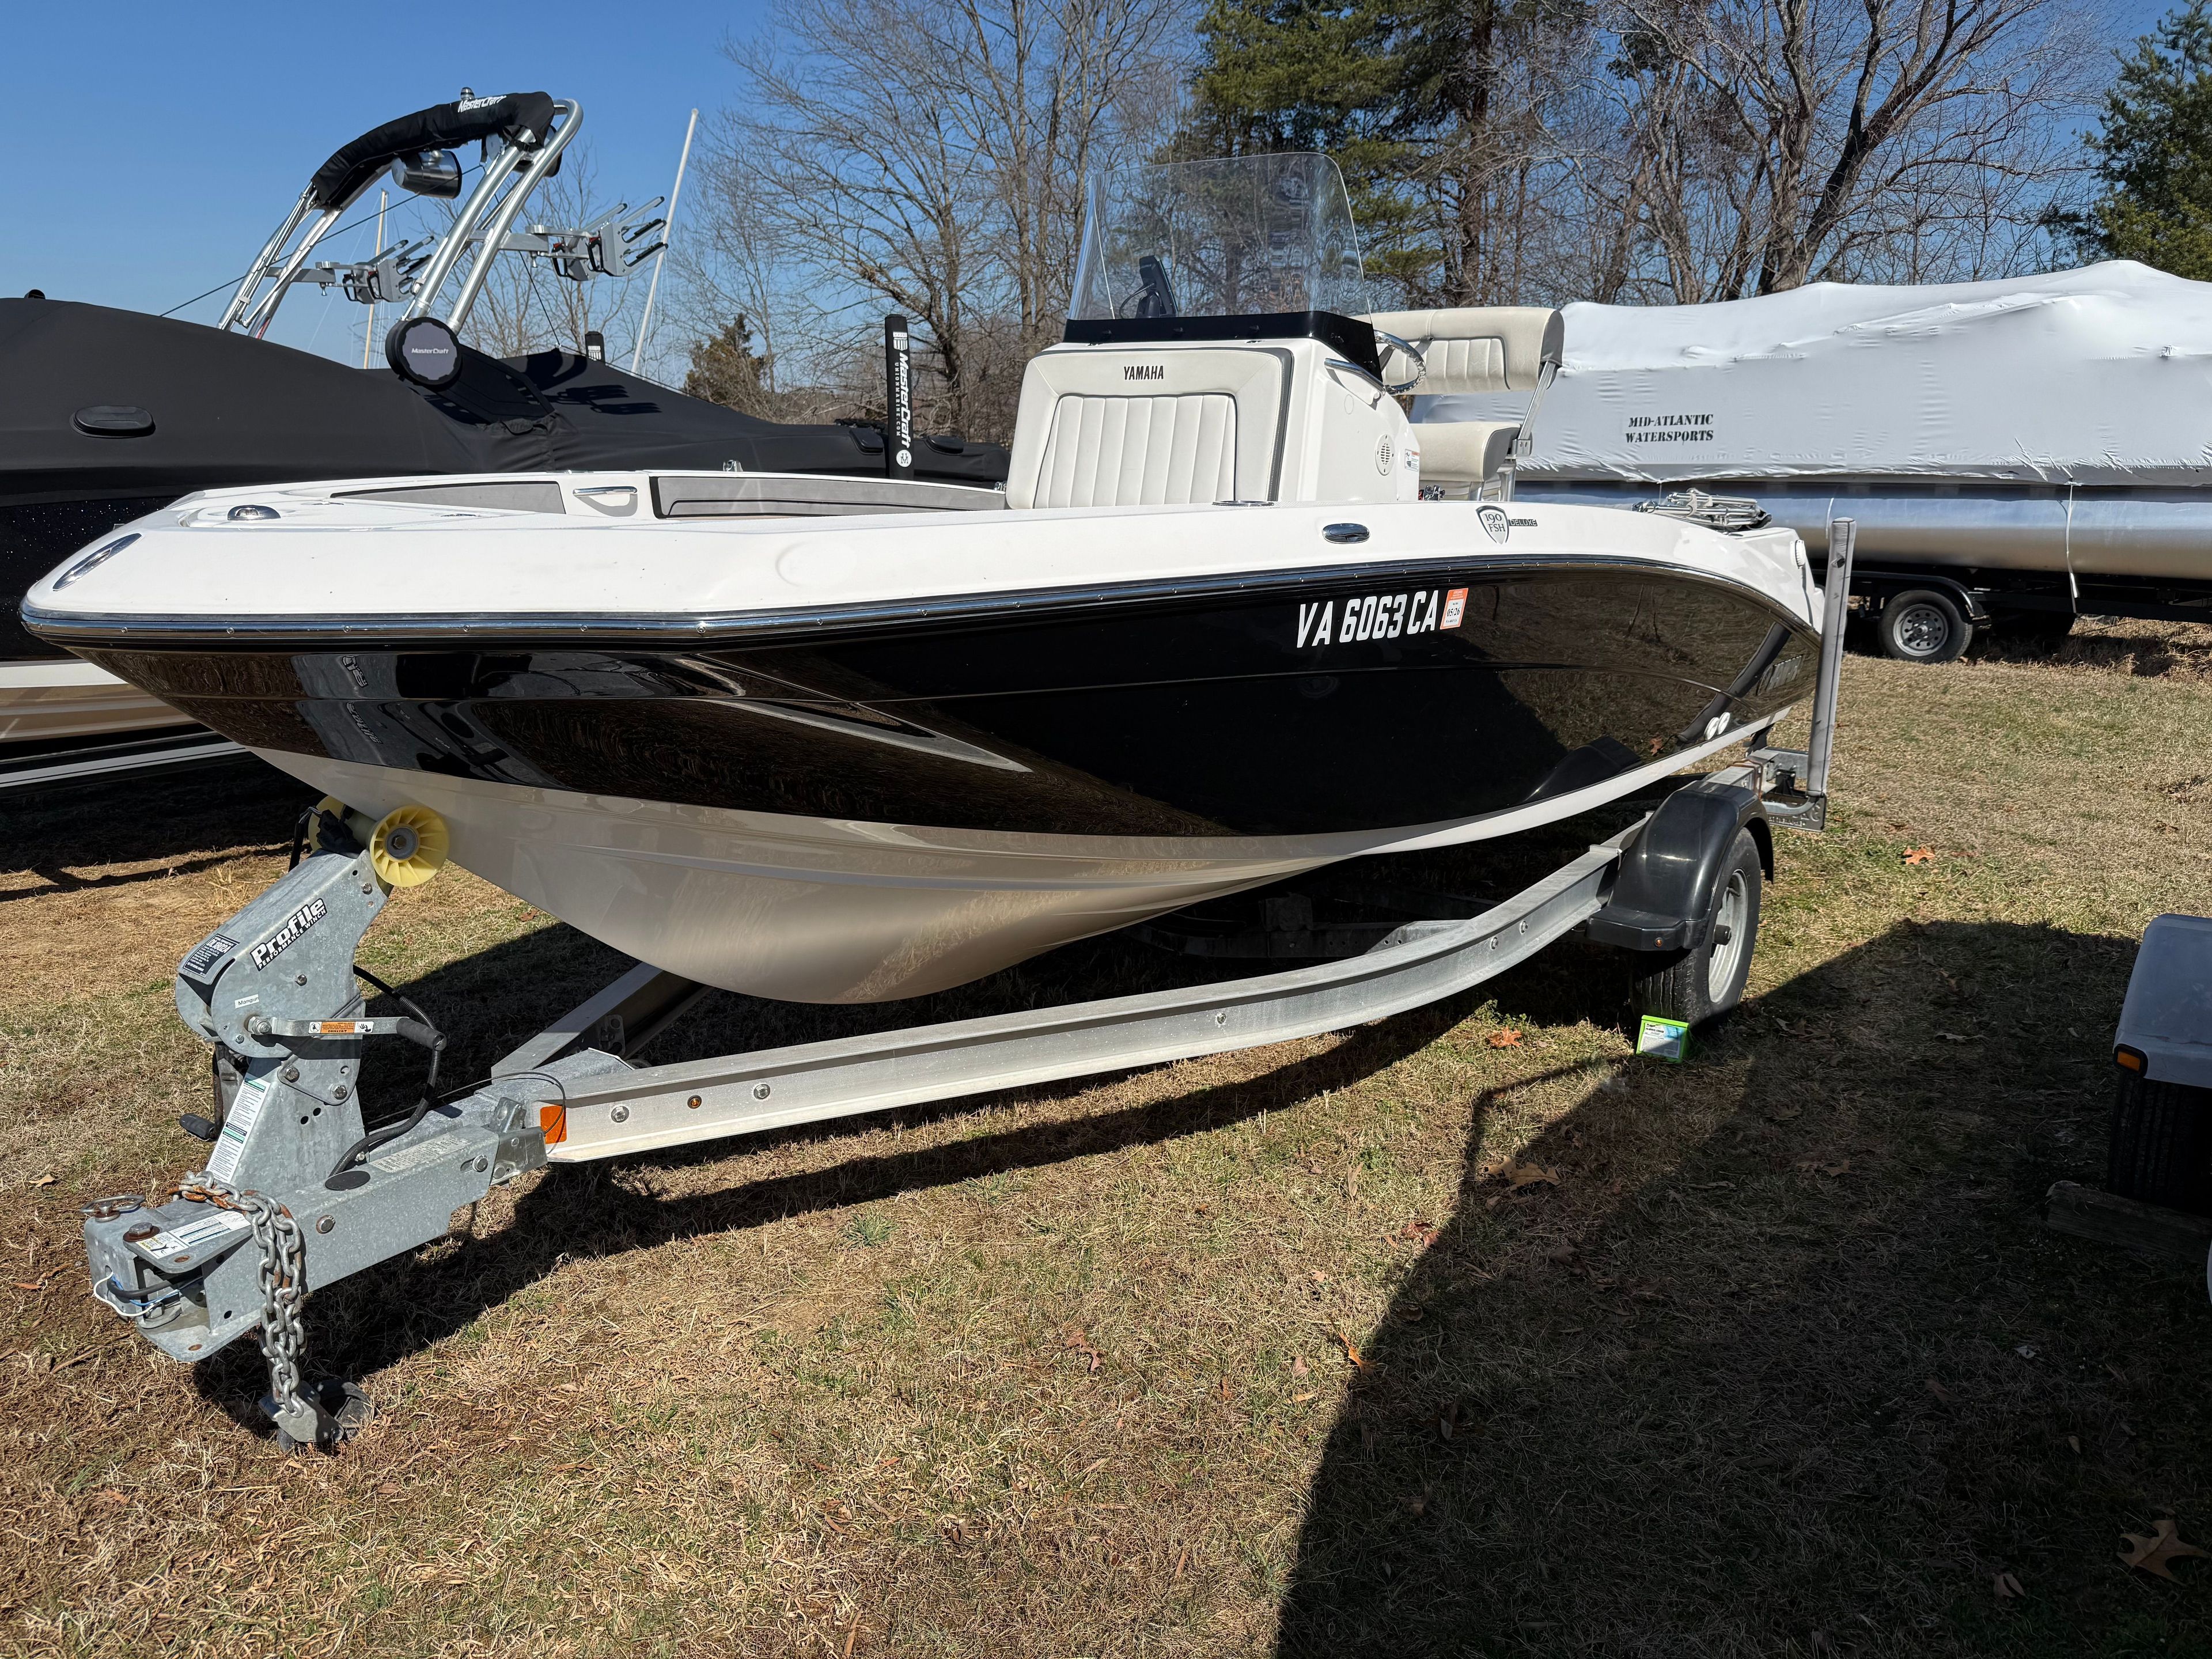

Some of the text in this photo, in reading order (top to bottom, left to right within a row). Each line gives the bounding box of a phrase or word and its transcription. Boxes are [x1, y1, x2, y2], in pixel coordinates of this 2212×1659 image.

[457, 95, 507, 113] MasterCraft
[1123, 365, 1164, 380] YAMAHA
[899, 352, 911, 449] MasterCraft
[1628, 414, 1714, 427] MID-ATLANTIC
[1625, 430, 1714, 444] WATERSPORTS
[1484, 513, 1502, 524] 190
[1488, 523, 1506, 532] FSH
[1296, 589, 1439, 648] VA 6063 CA
[1446, 608, 1460, 617] 05/26
[251, 899, 325, 965] Profile
[258, 908, 327, 969] PERFORMANCE WINCH
